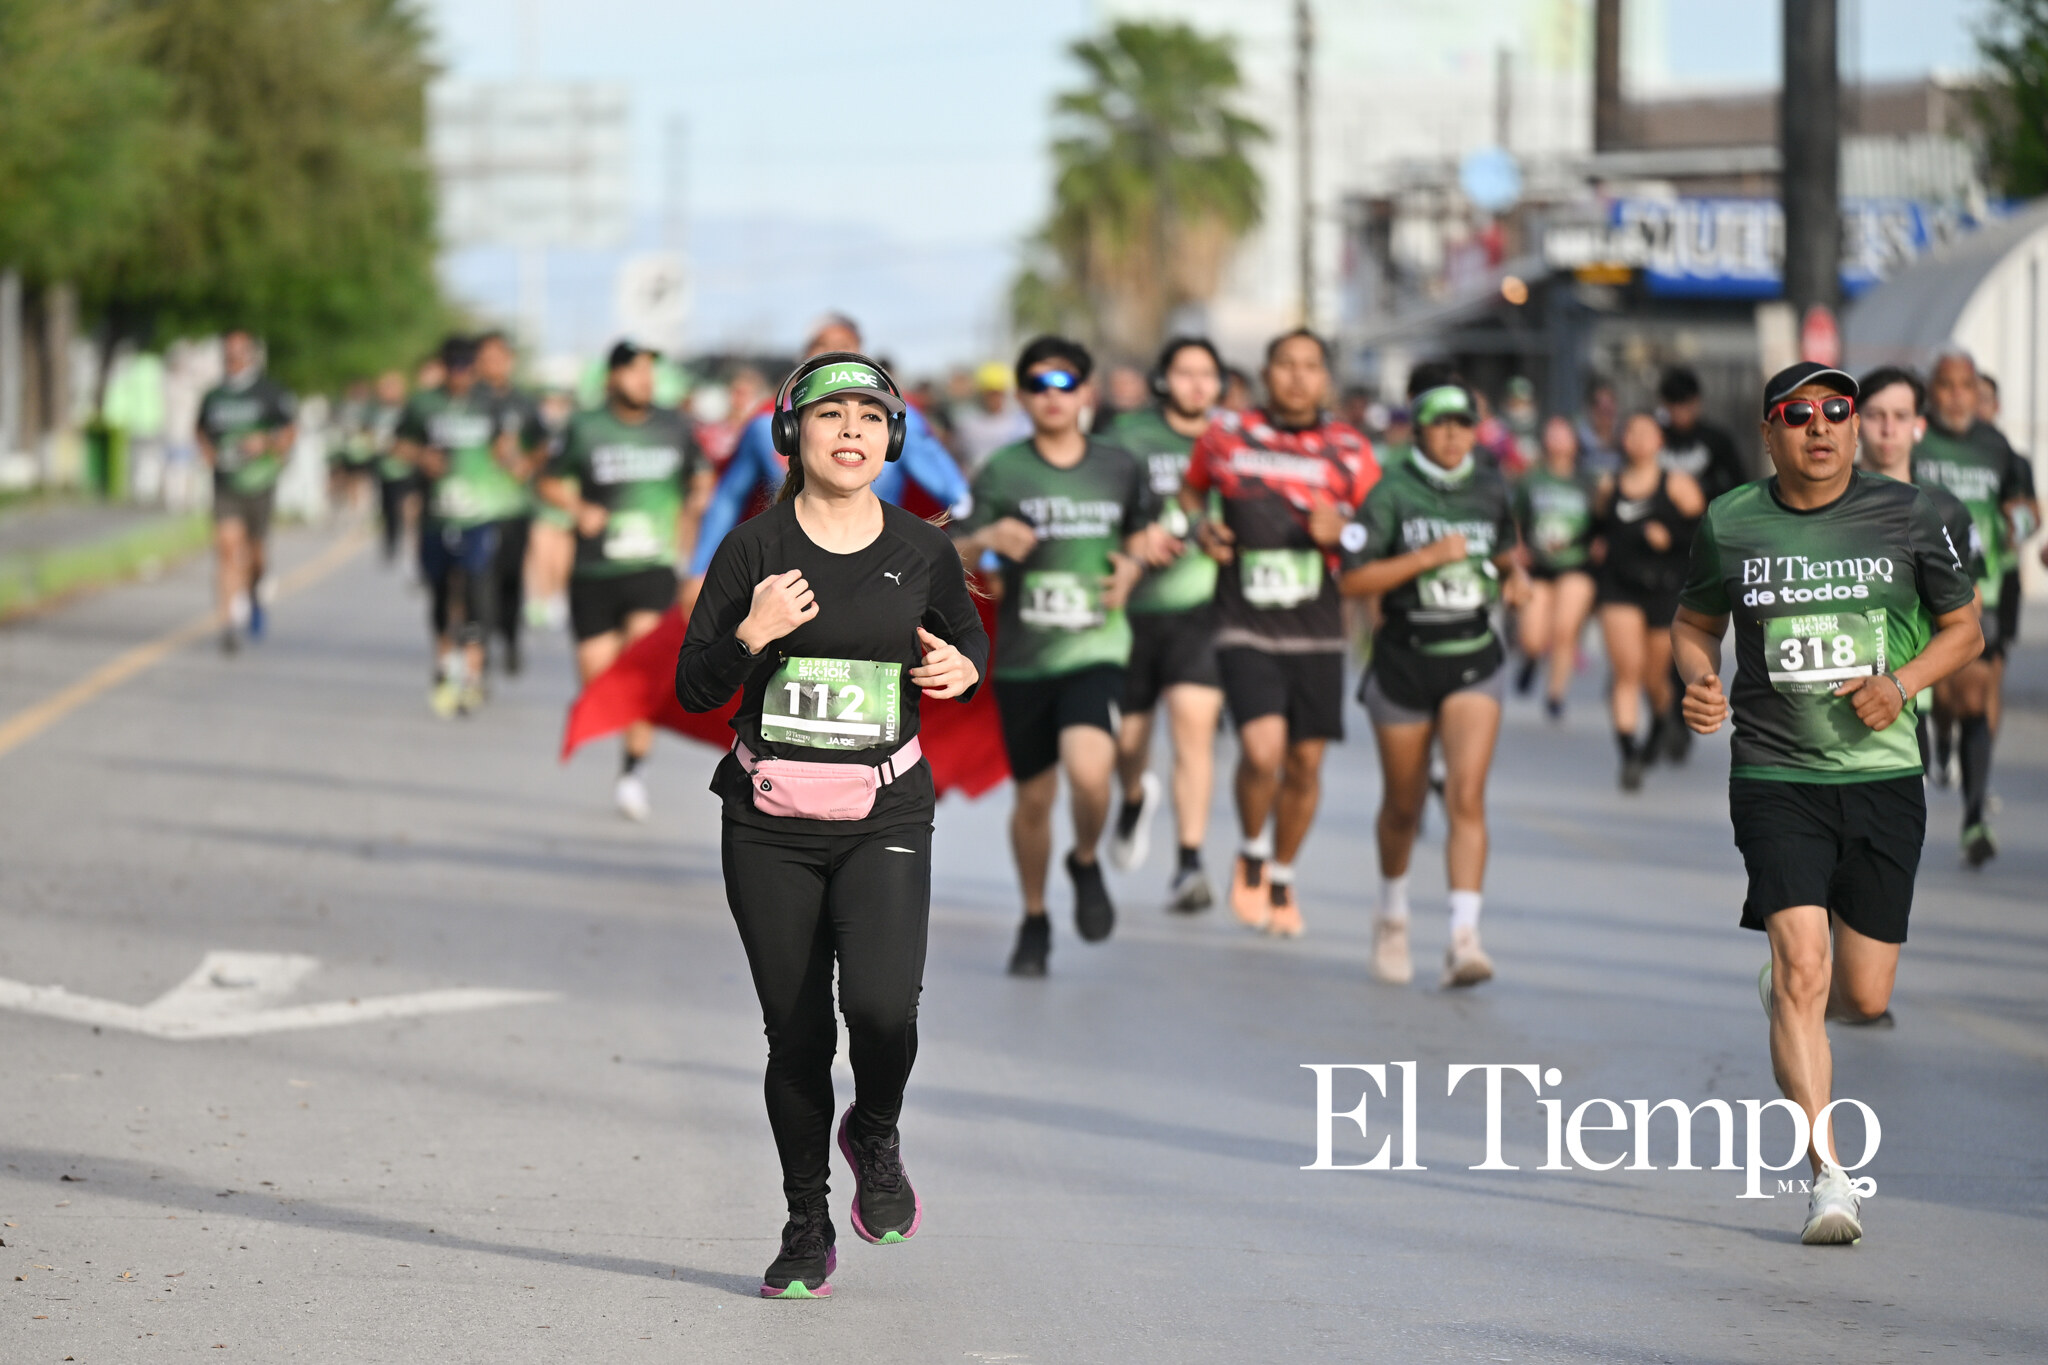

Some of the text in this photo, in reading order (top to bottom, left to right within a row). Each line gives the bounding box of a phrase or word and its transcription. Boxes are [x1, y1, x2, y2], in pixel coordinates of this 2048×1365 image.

[1742, 555, 1894, 585] El Tiempo
[1743, 583, 1869, 607] de todos
[1791, 615, 1839, 625] CARRERA
[1872, 614, 1884, 624] 318
[799, 659, 851, 668] CARRERA
[1780, 634, 1856, 671] 318
[884, 668, 898, 677] 112
[784, 682, 864, 720] 112
[886, 683, 895, 741] MEDALLA
